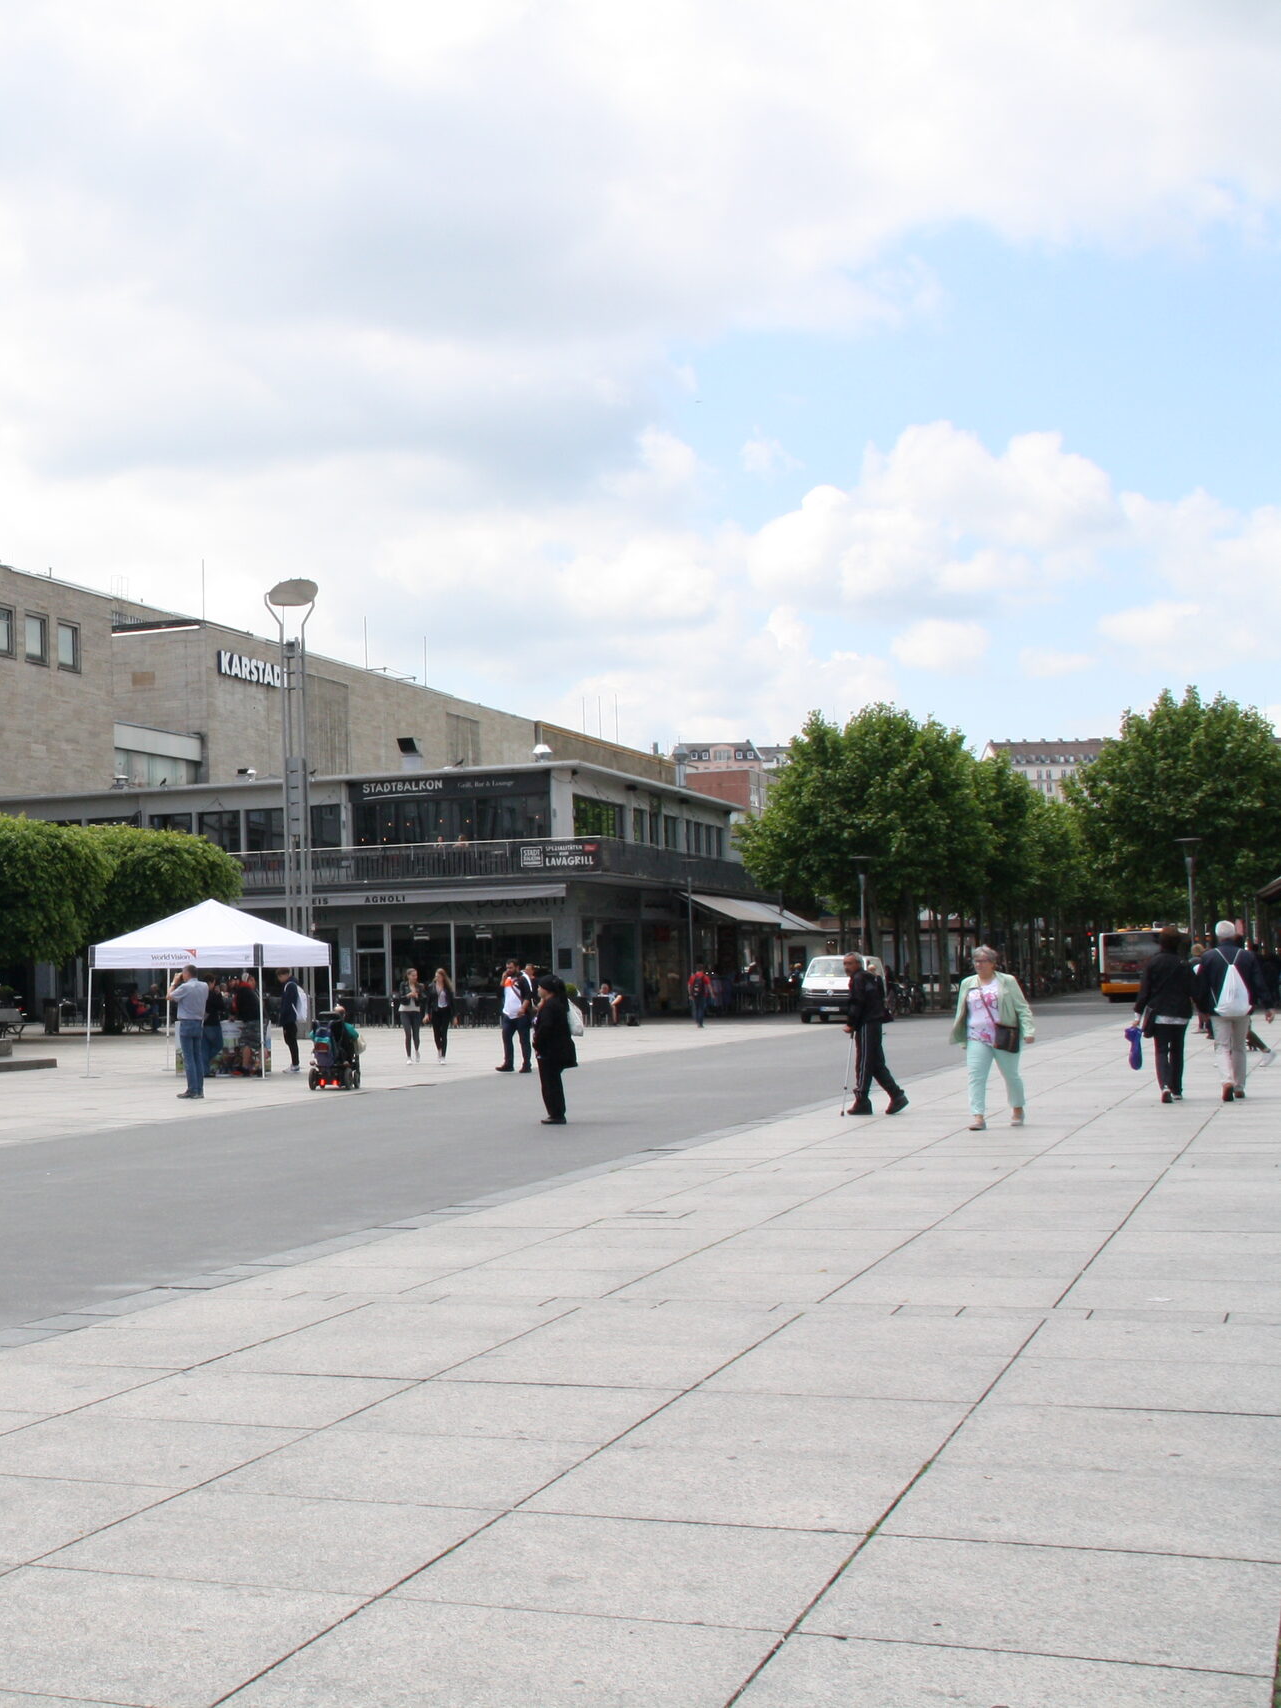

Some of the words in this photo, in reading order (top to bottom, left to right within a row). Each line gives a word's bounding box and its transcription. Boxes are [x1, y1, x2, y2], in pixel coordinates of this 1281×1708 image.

[363, 780, 442, 793] STADTBALKON
[545, 856, 594, 866] LAVAGRILL
[364, 895, 406, 904] AGNOLI
